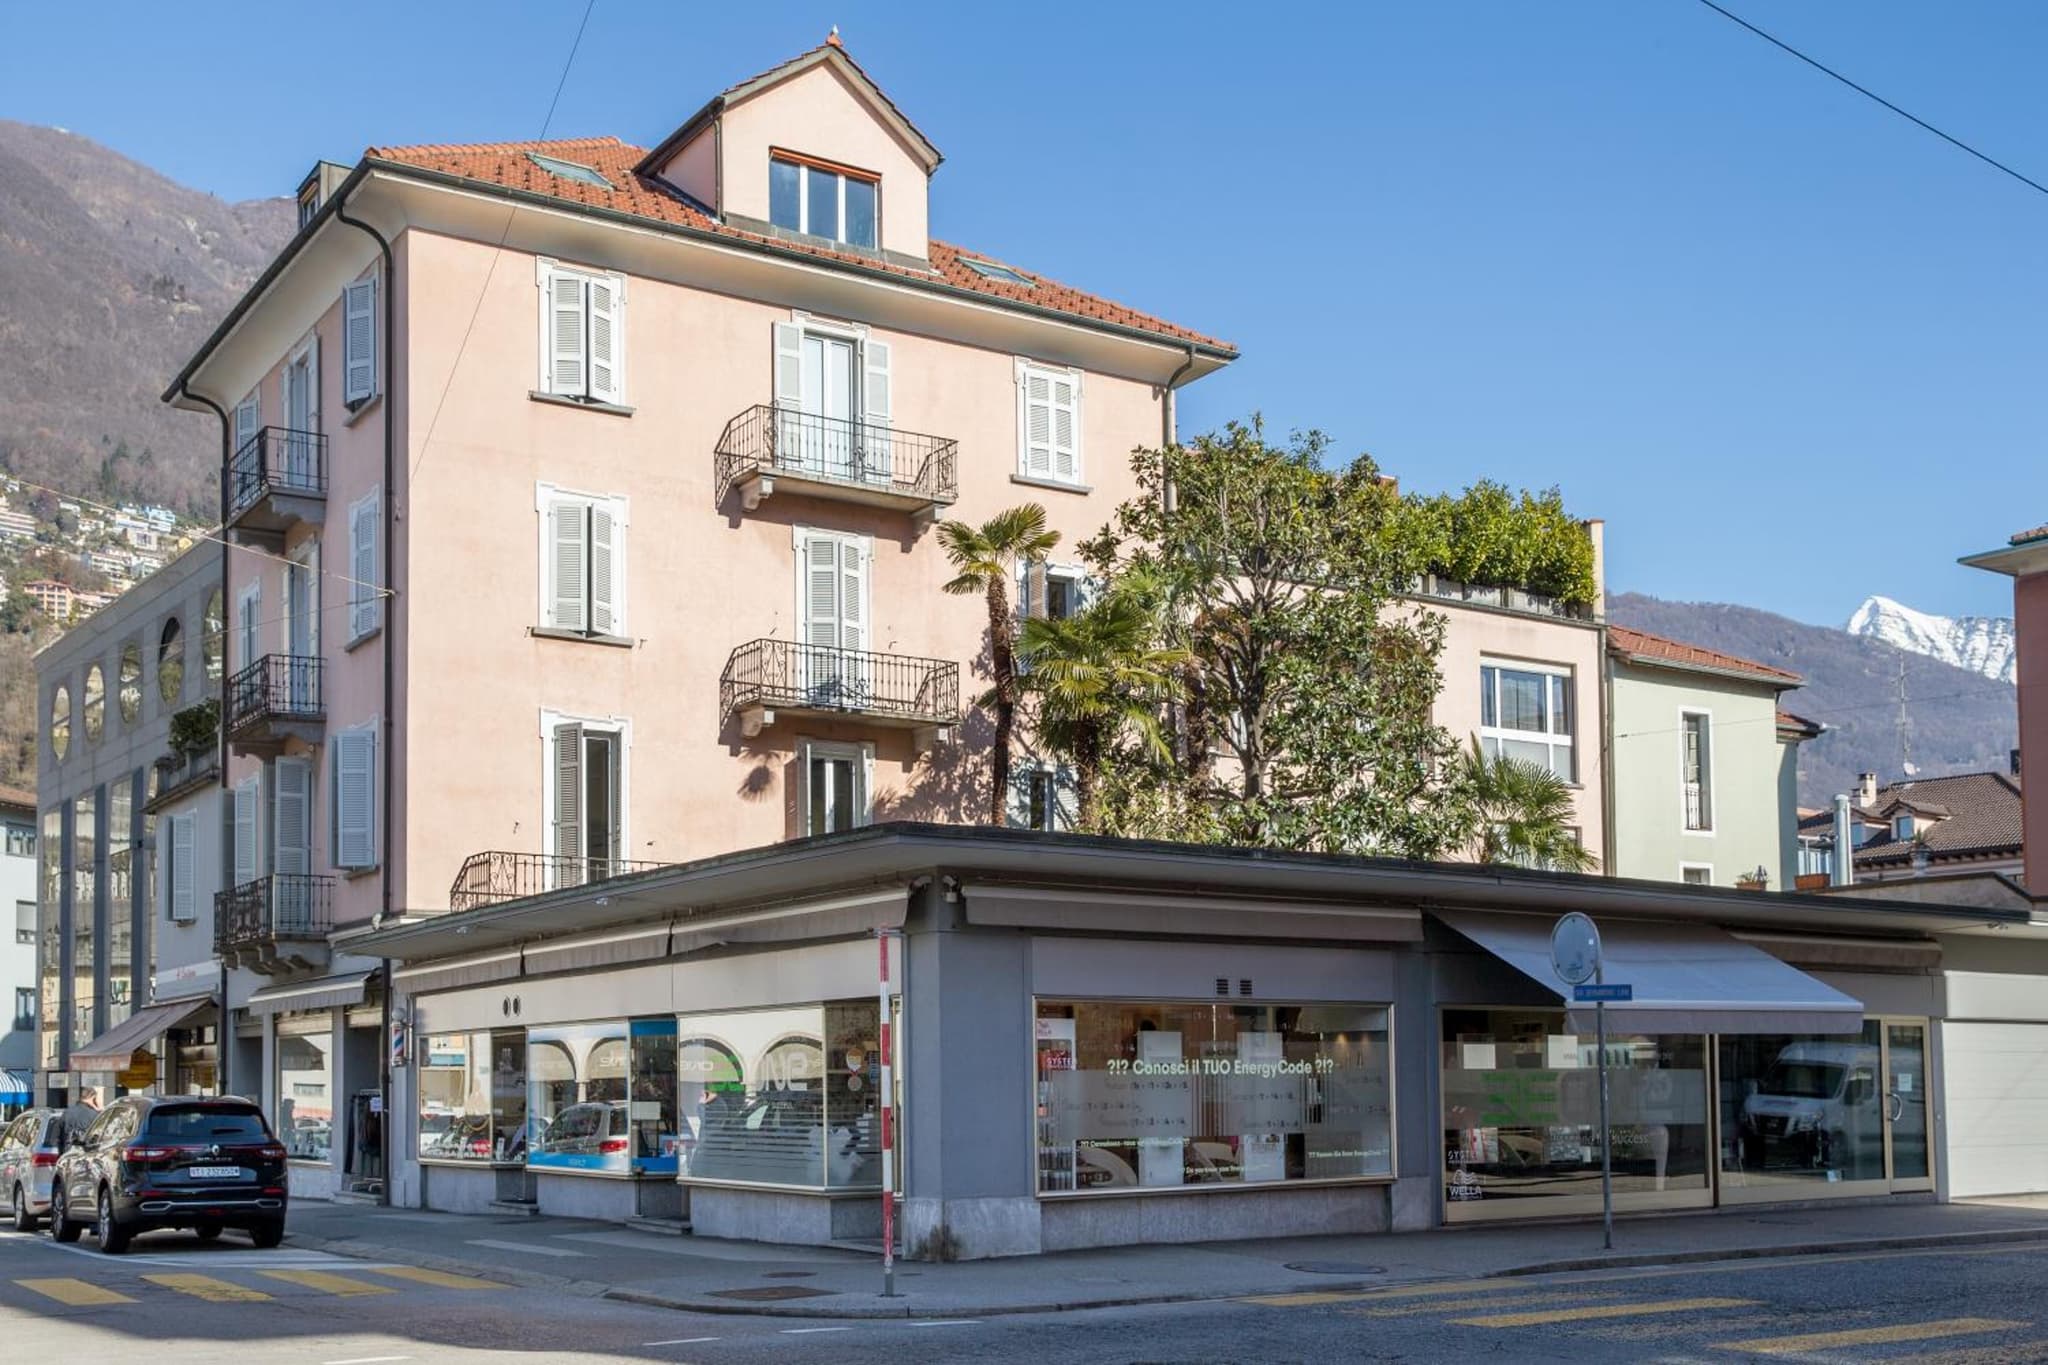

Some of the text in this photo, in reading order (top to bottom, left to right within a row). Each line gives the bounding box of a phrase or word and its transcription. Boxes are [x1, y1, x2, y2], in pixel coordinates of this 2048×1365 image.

[1107, 1059, 1128, 1075] ?!?
[1132, 1059, 1189, 1075] Conosci
[1192, 1059, 1200, 1074] il
[1202, 1060, 1231, 1075] TUO
[1233, 1059, 1312, 1078] EnergyCode
